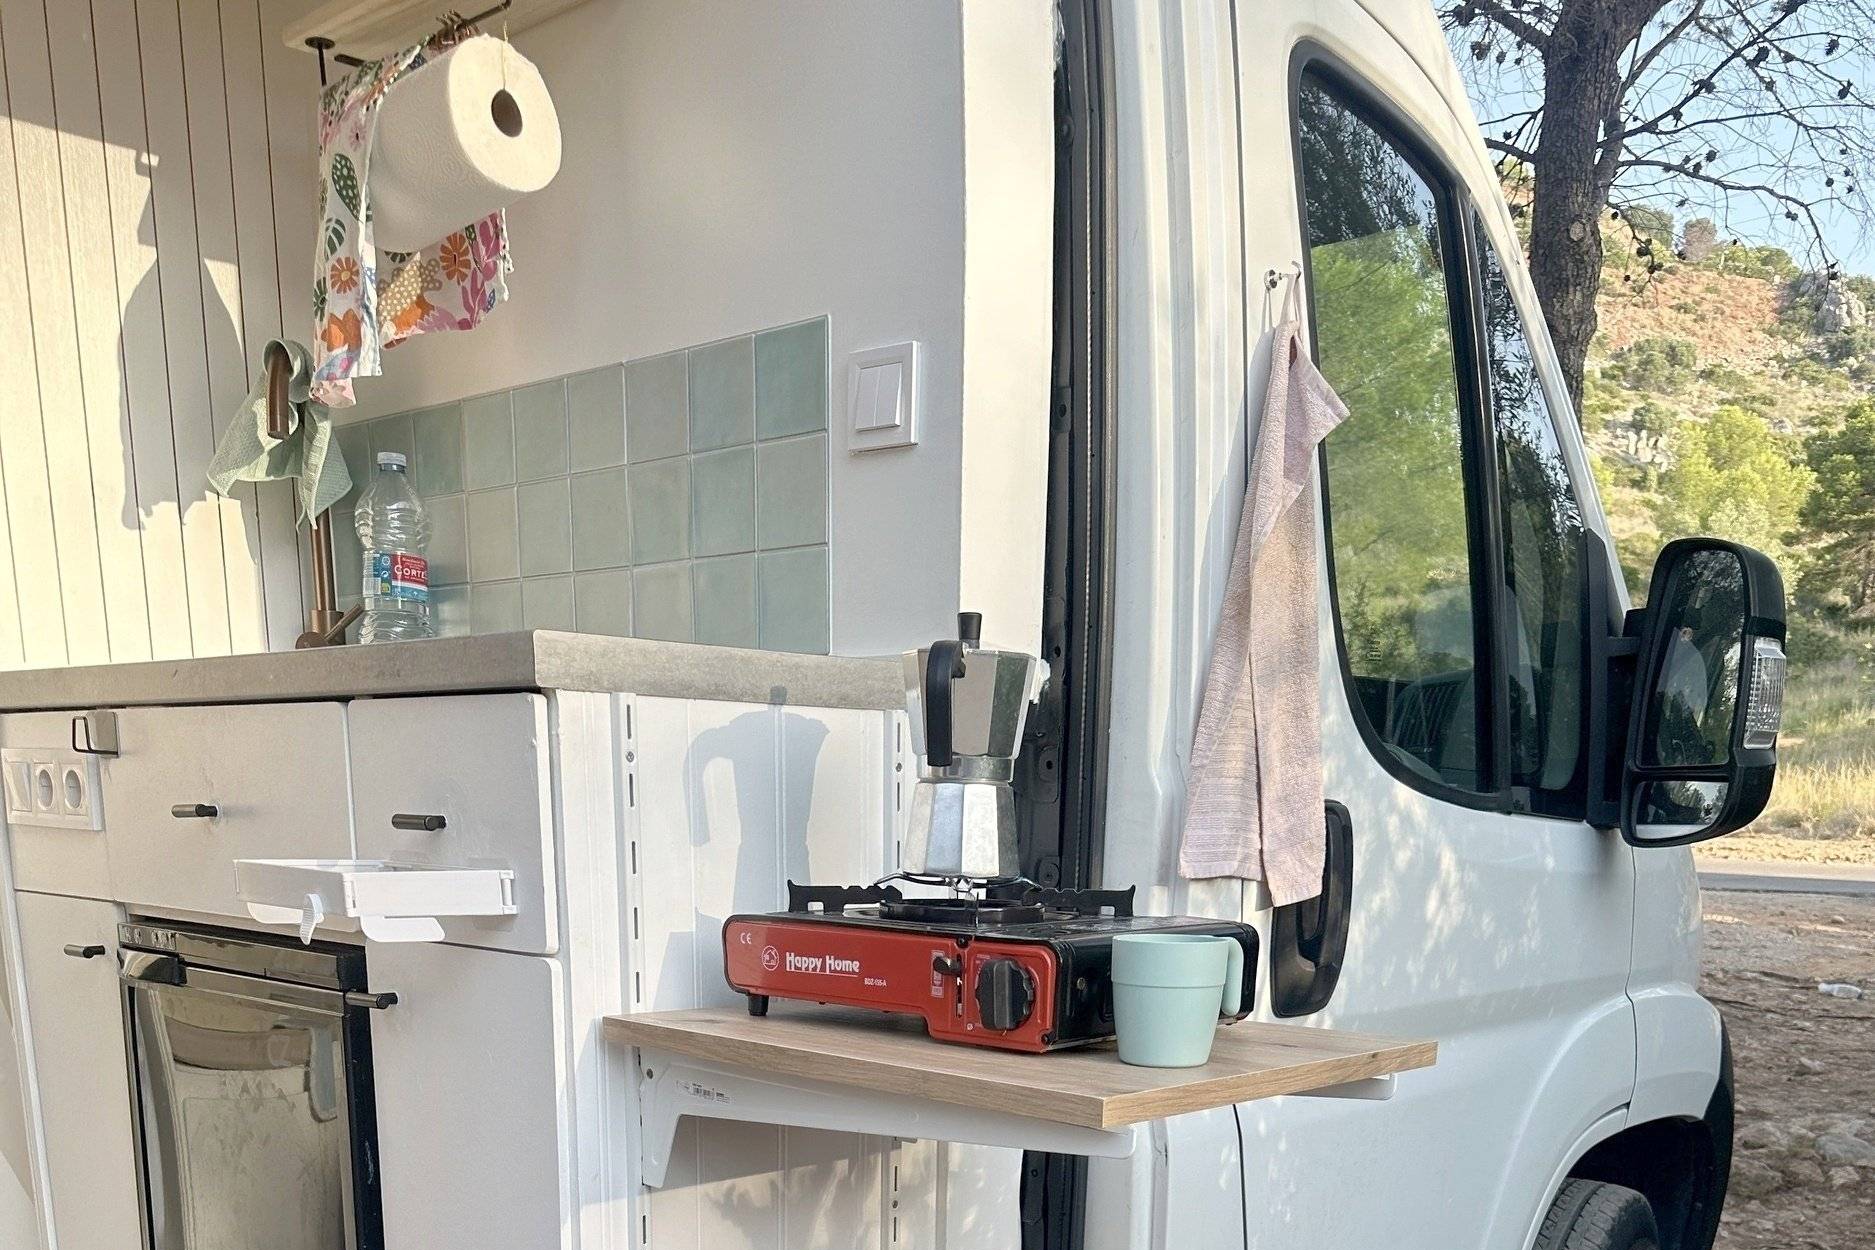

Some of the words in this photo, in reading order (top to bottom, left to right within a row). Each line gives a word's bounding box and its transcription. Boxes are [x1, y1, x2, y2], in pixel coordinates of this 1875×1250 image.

[740, 932, 752, 944] CE
[785, 951, 823, 973] Happy
[825, 955, 860, 974] Home
